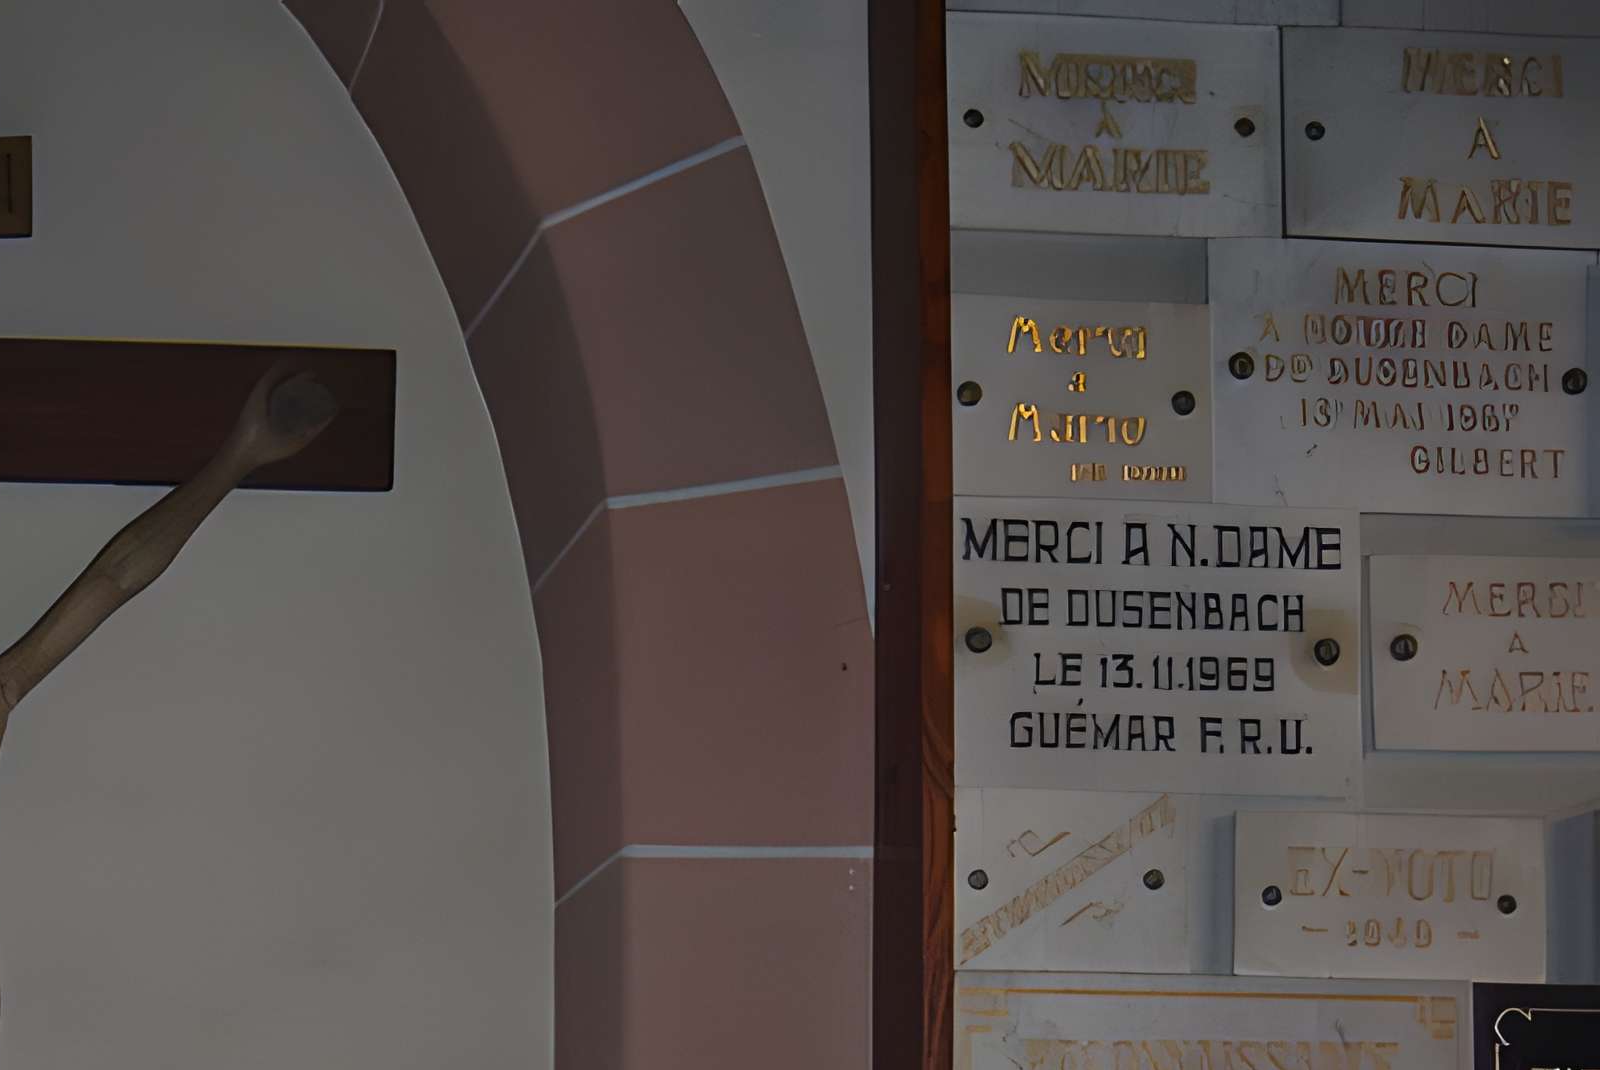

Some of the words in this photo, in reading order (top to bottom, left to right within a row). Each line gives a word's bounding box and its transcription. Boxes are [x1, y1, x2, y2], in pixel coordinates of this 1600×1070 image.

[1401, 47, 1564, 97] MERCI
[1397, 175, 1574, 225] MARIE
[1333, 264, 1479, 309] MERCI
[1445, 320, 1554, 353] DAME
[1409, 443, 1566, 481] GILBERT
[960, 517, 1104, 564] MERCI
[1000, 587, 1051, 626] DE
[1065, 588, 1305, 632] DUSENBACH
[1032, 652, 1084, 687] LE
[1008, 696, 1178, 753] GUÉMAR
